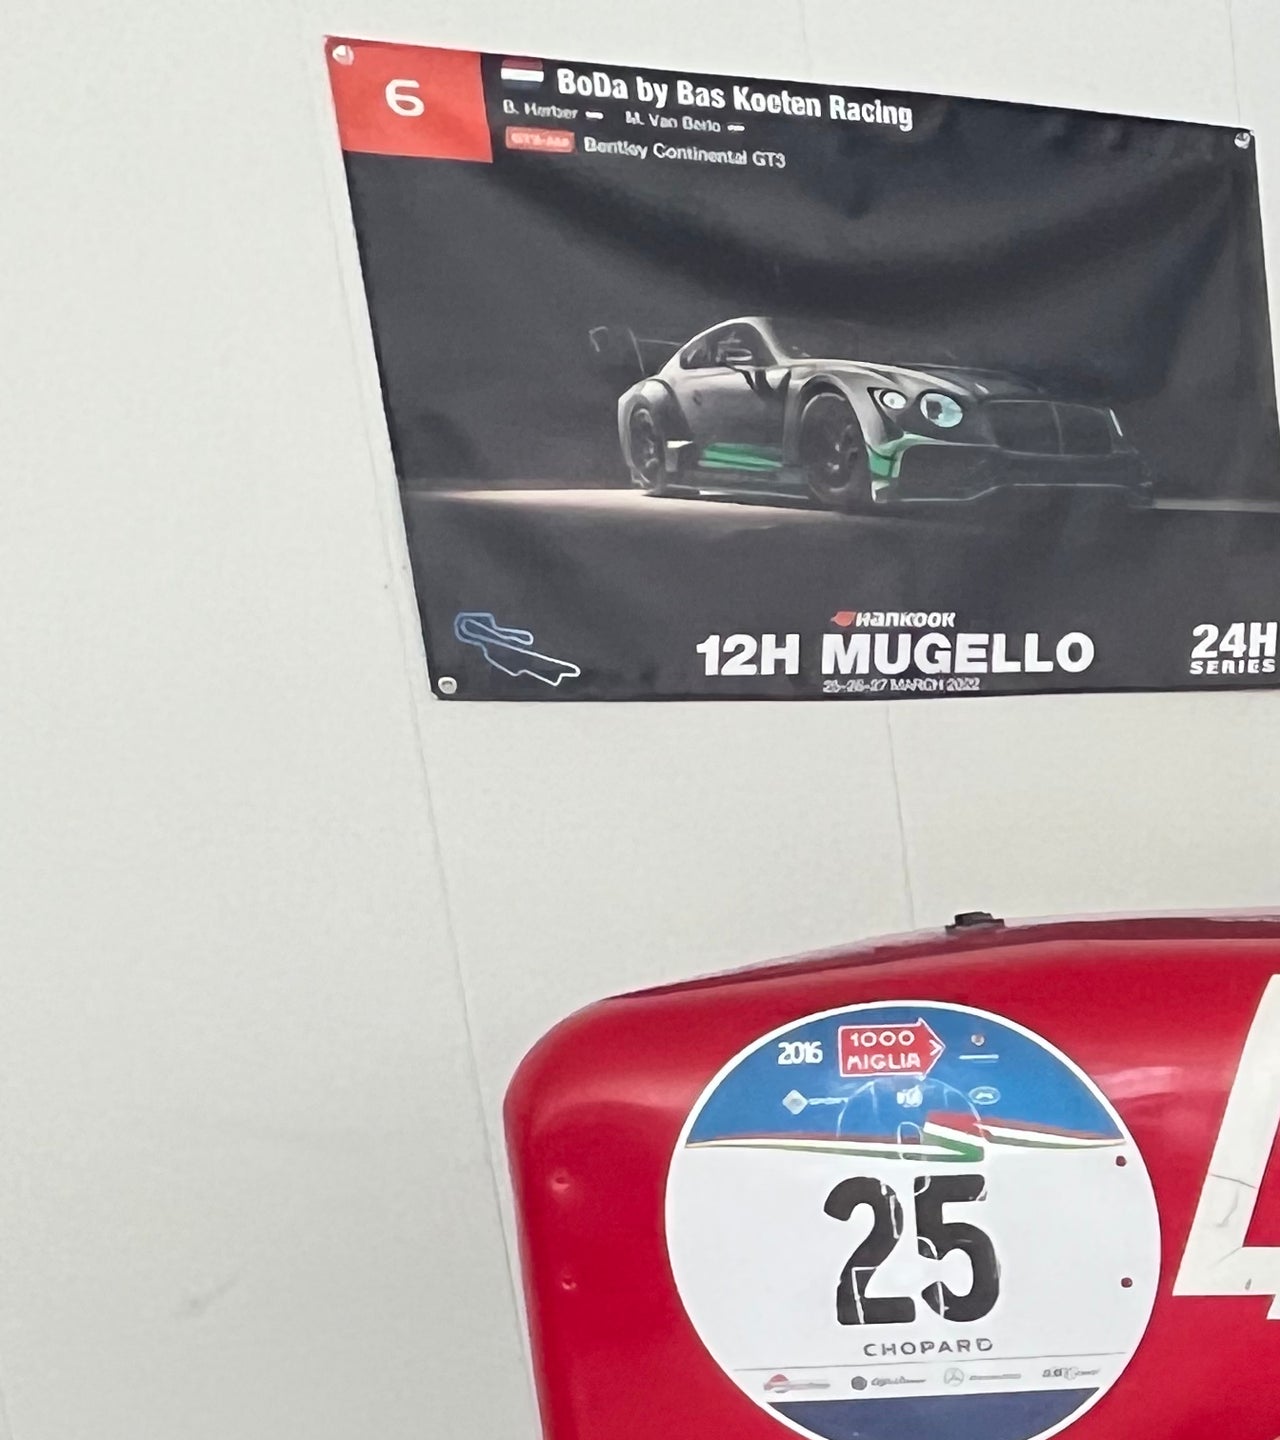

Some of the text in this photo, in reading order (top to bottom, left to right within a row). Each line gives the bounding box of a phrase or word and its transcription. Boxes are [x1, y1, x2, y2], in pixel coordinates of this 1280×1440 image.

[385, 78, 425, 117] 6
[556, 68, 629, 100] BoDa
[636, 76, 669, 109] by
[676, 79, 727, 110] Bas
[829, 94, 914, 132] Racing
[583, 136, 649, 159] Bentley
[652, 143, 749, 165] Continental
[751, 151, 786, 169] GT3
[696, 632, 1095, 676] 12H MUGELLO
[1190, 621, 1279, 659] 24H
[1188, 658, 1276, 675] SERIES
[890, 677, 944, 692] MARCH
[849, 1028, 916, 1048] 1000
[776, 1041, 824, 1066] 2016
[846, 1050, 921, 1072] MIGLIA
[823, 1174, 1002, 1326] 25
[863, 1336, 994, 1357] CHOPARD
